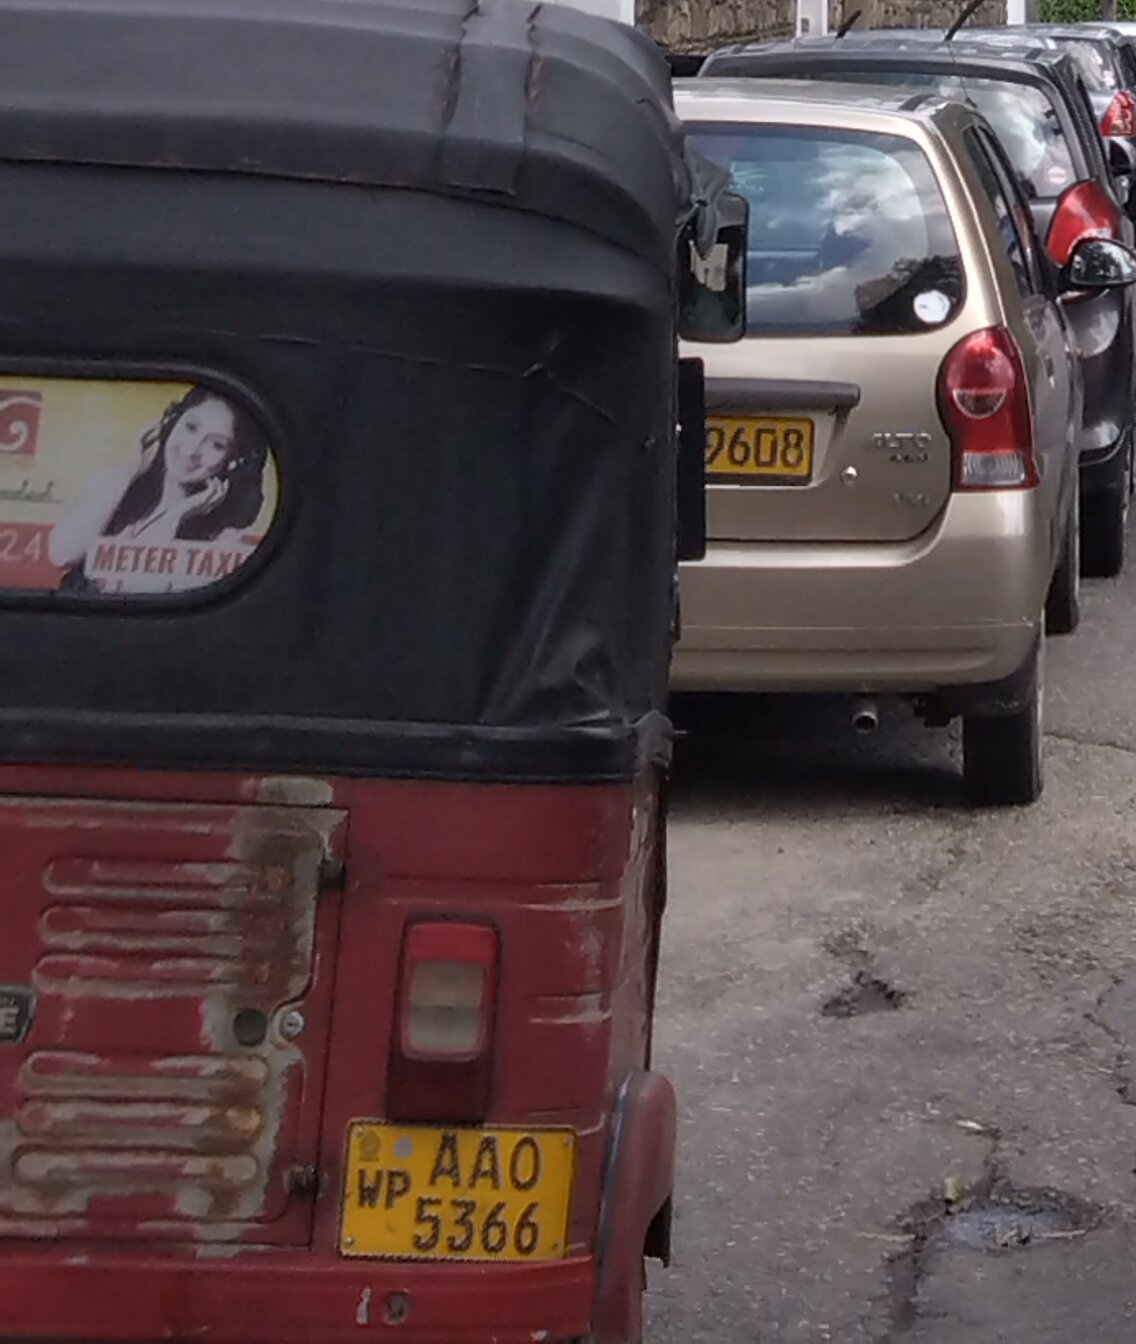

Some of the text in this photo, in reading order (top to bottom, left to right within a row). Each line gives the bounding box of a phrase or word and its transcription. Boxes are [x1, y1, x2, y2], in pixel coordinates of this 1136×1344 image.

[705, 426, 804, 468] 9608
[93, 543, 244, 578] METER TAXI
[356, 1167, 412, 1210] WP
[412, 1195, 540, 1255] 5366
